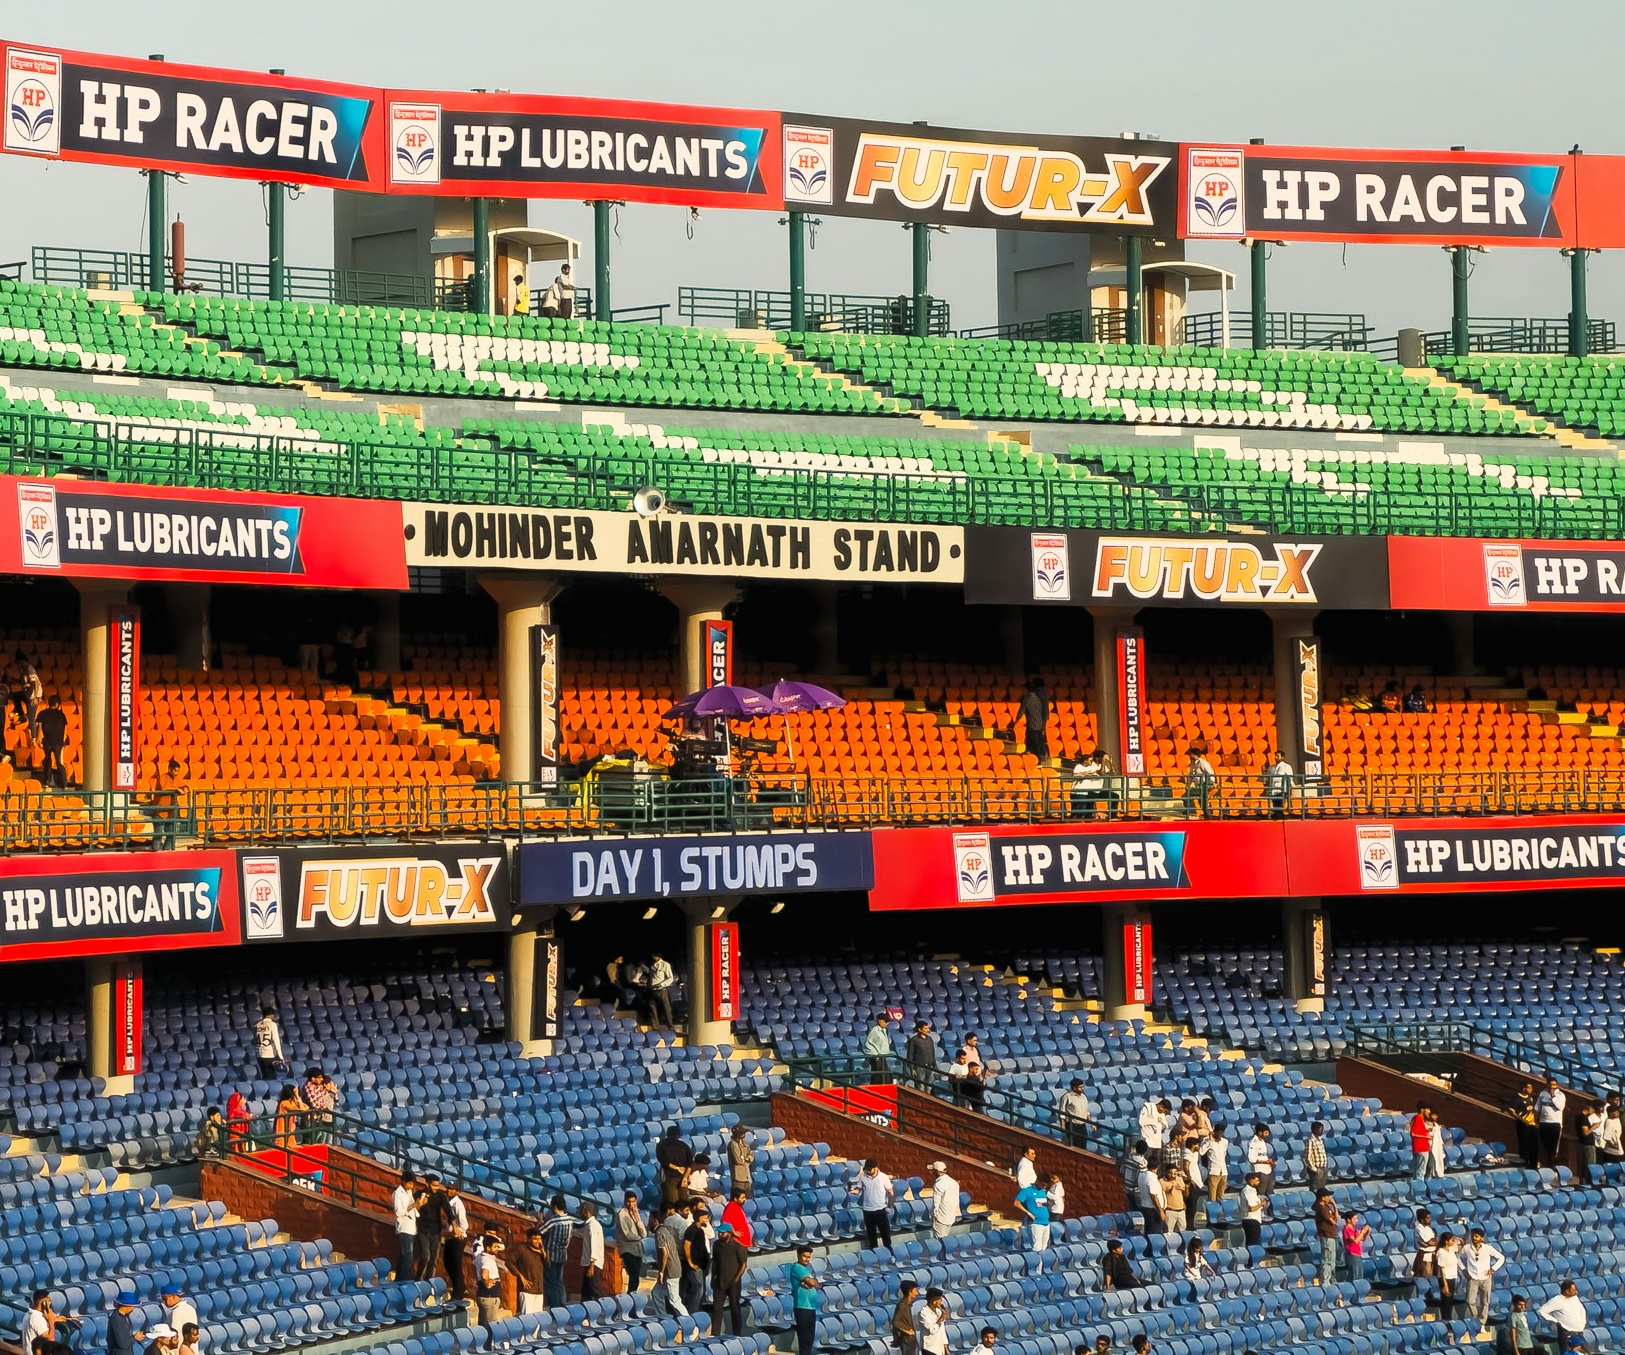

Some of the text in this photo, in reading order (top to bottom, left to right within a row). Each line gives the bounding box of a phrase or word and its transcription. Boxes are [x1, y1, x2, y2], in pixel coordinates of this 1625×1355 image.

[22, 89, 45, 106] HP
[79, 79, 338, 164] HP RACER
[453, 125, 747, 180] HP LUBRICANTS
[849, 138, 1164, 221] FUTUR-X
[1262, 169, 1527, 225] HP RACER
[31, 514, 47, 530] HP
[66, 507, 291, 560] HP LUBRICANTS
[424, 510, 941, 573] MOHINDER AMARNATH STAND
[1097, 541, 1315, 599] FUTUR-X
[1534, 556, 1588, 594] HP
[120, 620, 133, 758] HP LUBRICANTS
[541, 628, 556, 760] FUTUR-X
[1126, 638, 1140, 750] HP LUBRICANTS
[1300, 640, 1319, 756] FUTUR-X
[572, 843, 817, 897] DAY 1, STUMPS
[1001, 842, 1169, 886] HP RACER
[1405, 839, 1451, 873] HP
[3, 882, 212, 931] HP LUBRICANTS
[298, 861, 493, 924] FUTUR-X
